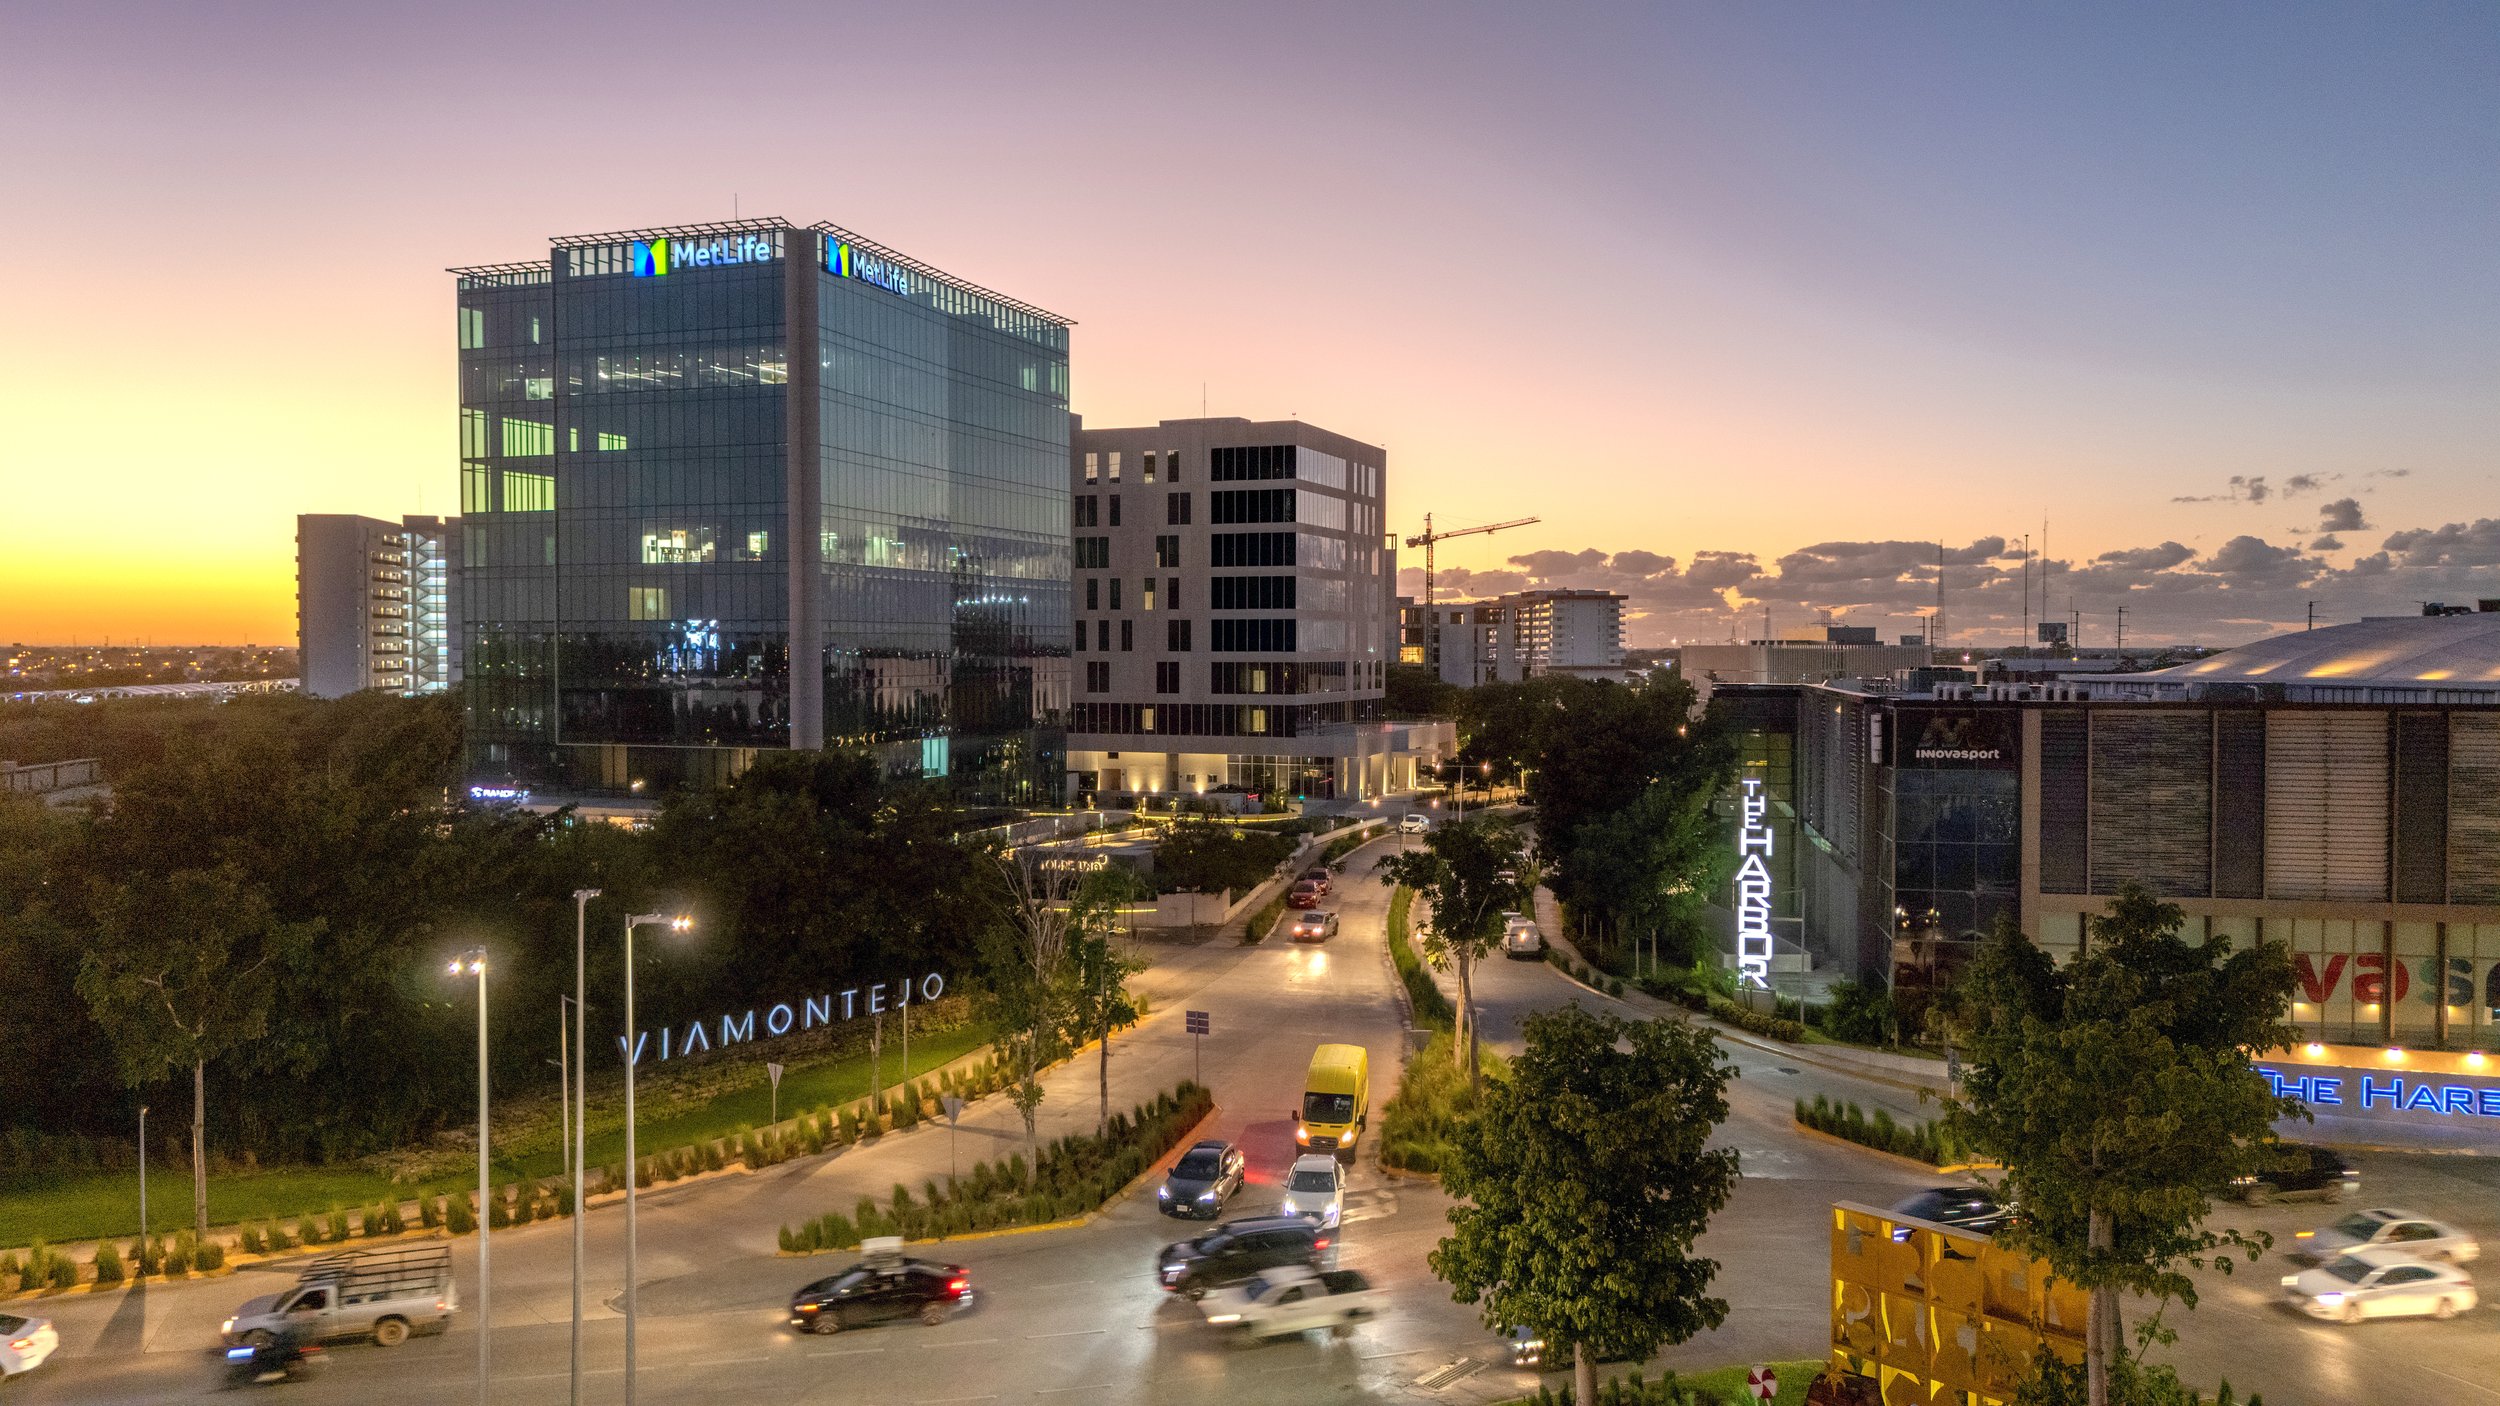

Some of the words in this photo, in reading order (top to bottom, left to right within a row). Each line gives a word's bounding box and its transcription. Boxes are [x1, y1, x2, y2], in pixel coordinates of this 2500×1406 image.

[673, 236, 770, 268] MetLife
[852, 255, 908, 295] MetLife
[1742, 780, 1765, 829] THE
[1735, 828, 1773, 989] HARBOR
